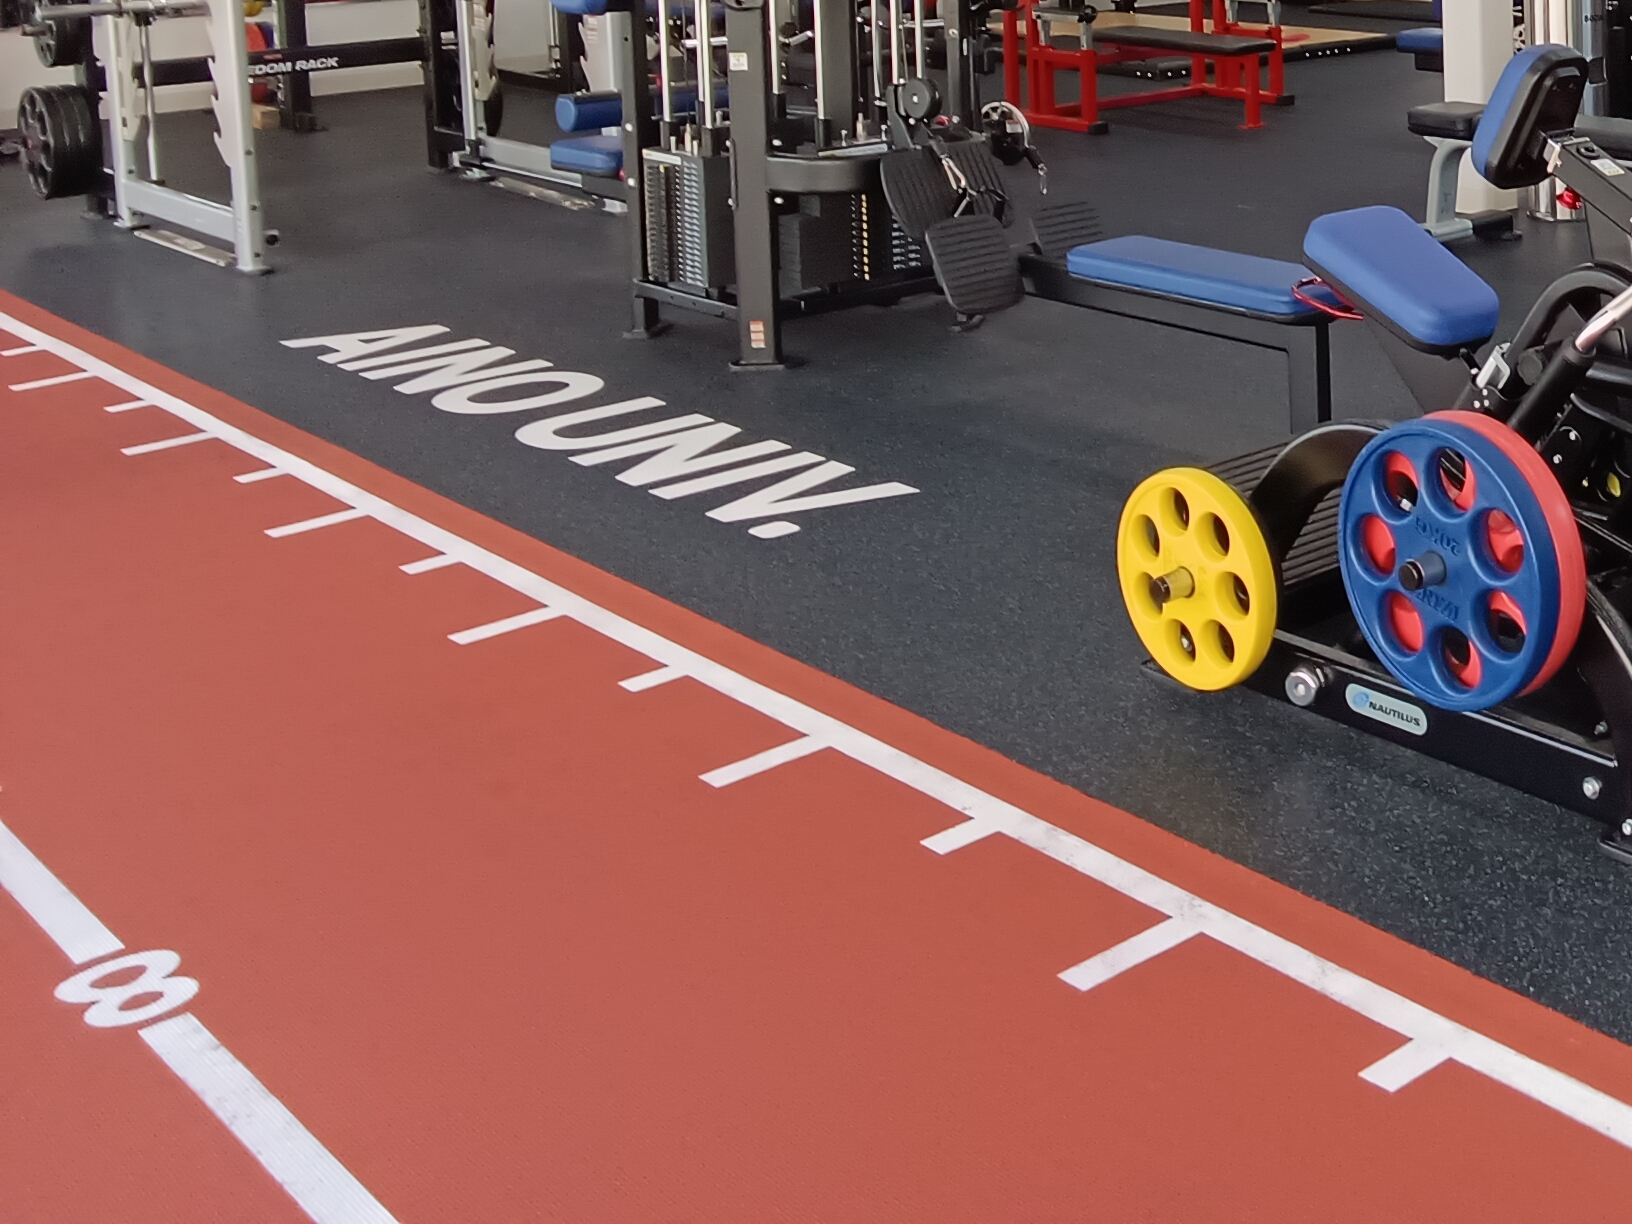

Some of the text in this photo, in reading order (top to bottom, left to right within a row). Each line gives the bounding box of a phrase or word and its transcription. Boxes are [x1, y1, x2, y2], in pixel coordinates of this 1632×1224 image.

[295, 57, 339, 71] RACK
[279, 324, 921, 540] AINO UNIV.
[1368, 700, 1421, 727] NAUTILUS
[53, 949, 200, 1028] 8
